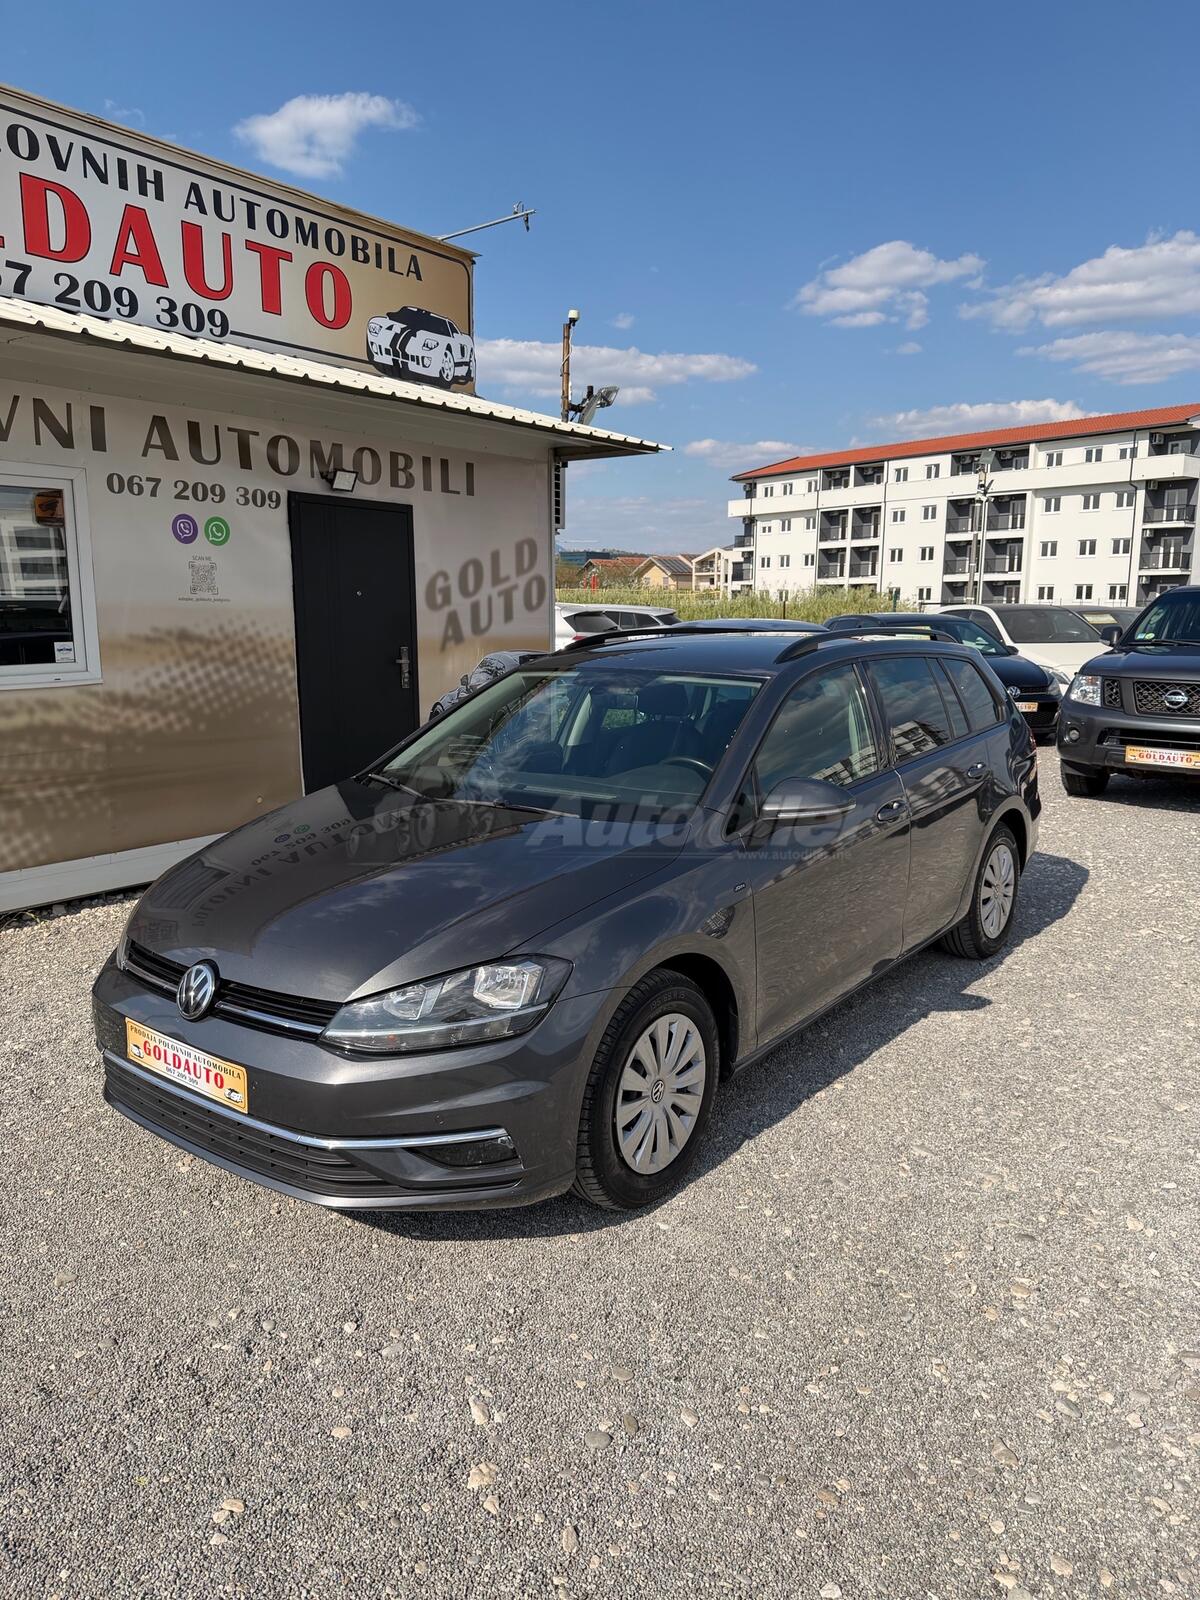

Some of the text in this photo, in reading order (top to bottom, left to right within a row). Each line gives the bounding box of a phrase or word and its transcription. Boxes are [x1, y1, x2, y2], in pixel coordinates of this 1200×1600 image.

[0, 124, 424, 282] OVNIH AUTOMOBILA
[0, 171, 353, 330] DAUTO
[0, 259, 230, 338] 7 209 309
[106, 472, 282, 509] 067 209 309
[141, 415, 475, 497] AUTOMOBILI
[425, 537, 538, 612] GOLD
[440, 573, 546, 653] AUTO
[1138, 752, 1193, 764] GOLDAUTO
[130, 1024, 241, 1080] PRODAJA POLOVNIH AUTOMOBILA
[143, 1040, 224, 1089] GOLDAUTO
